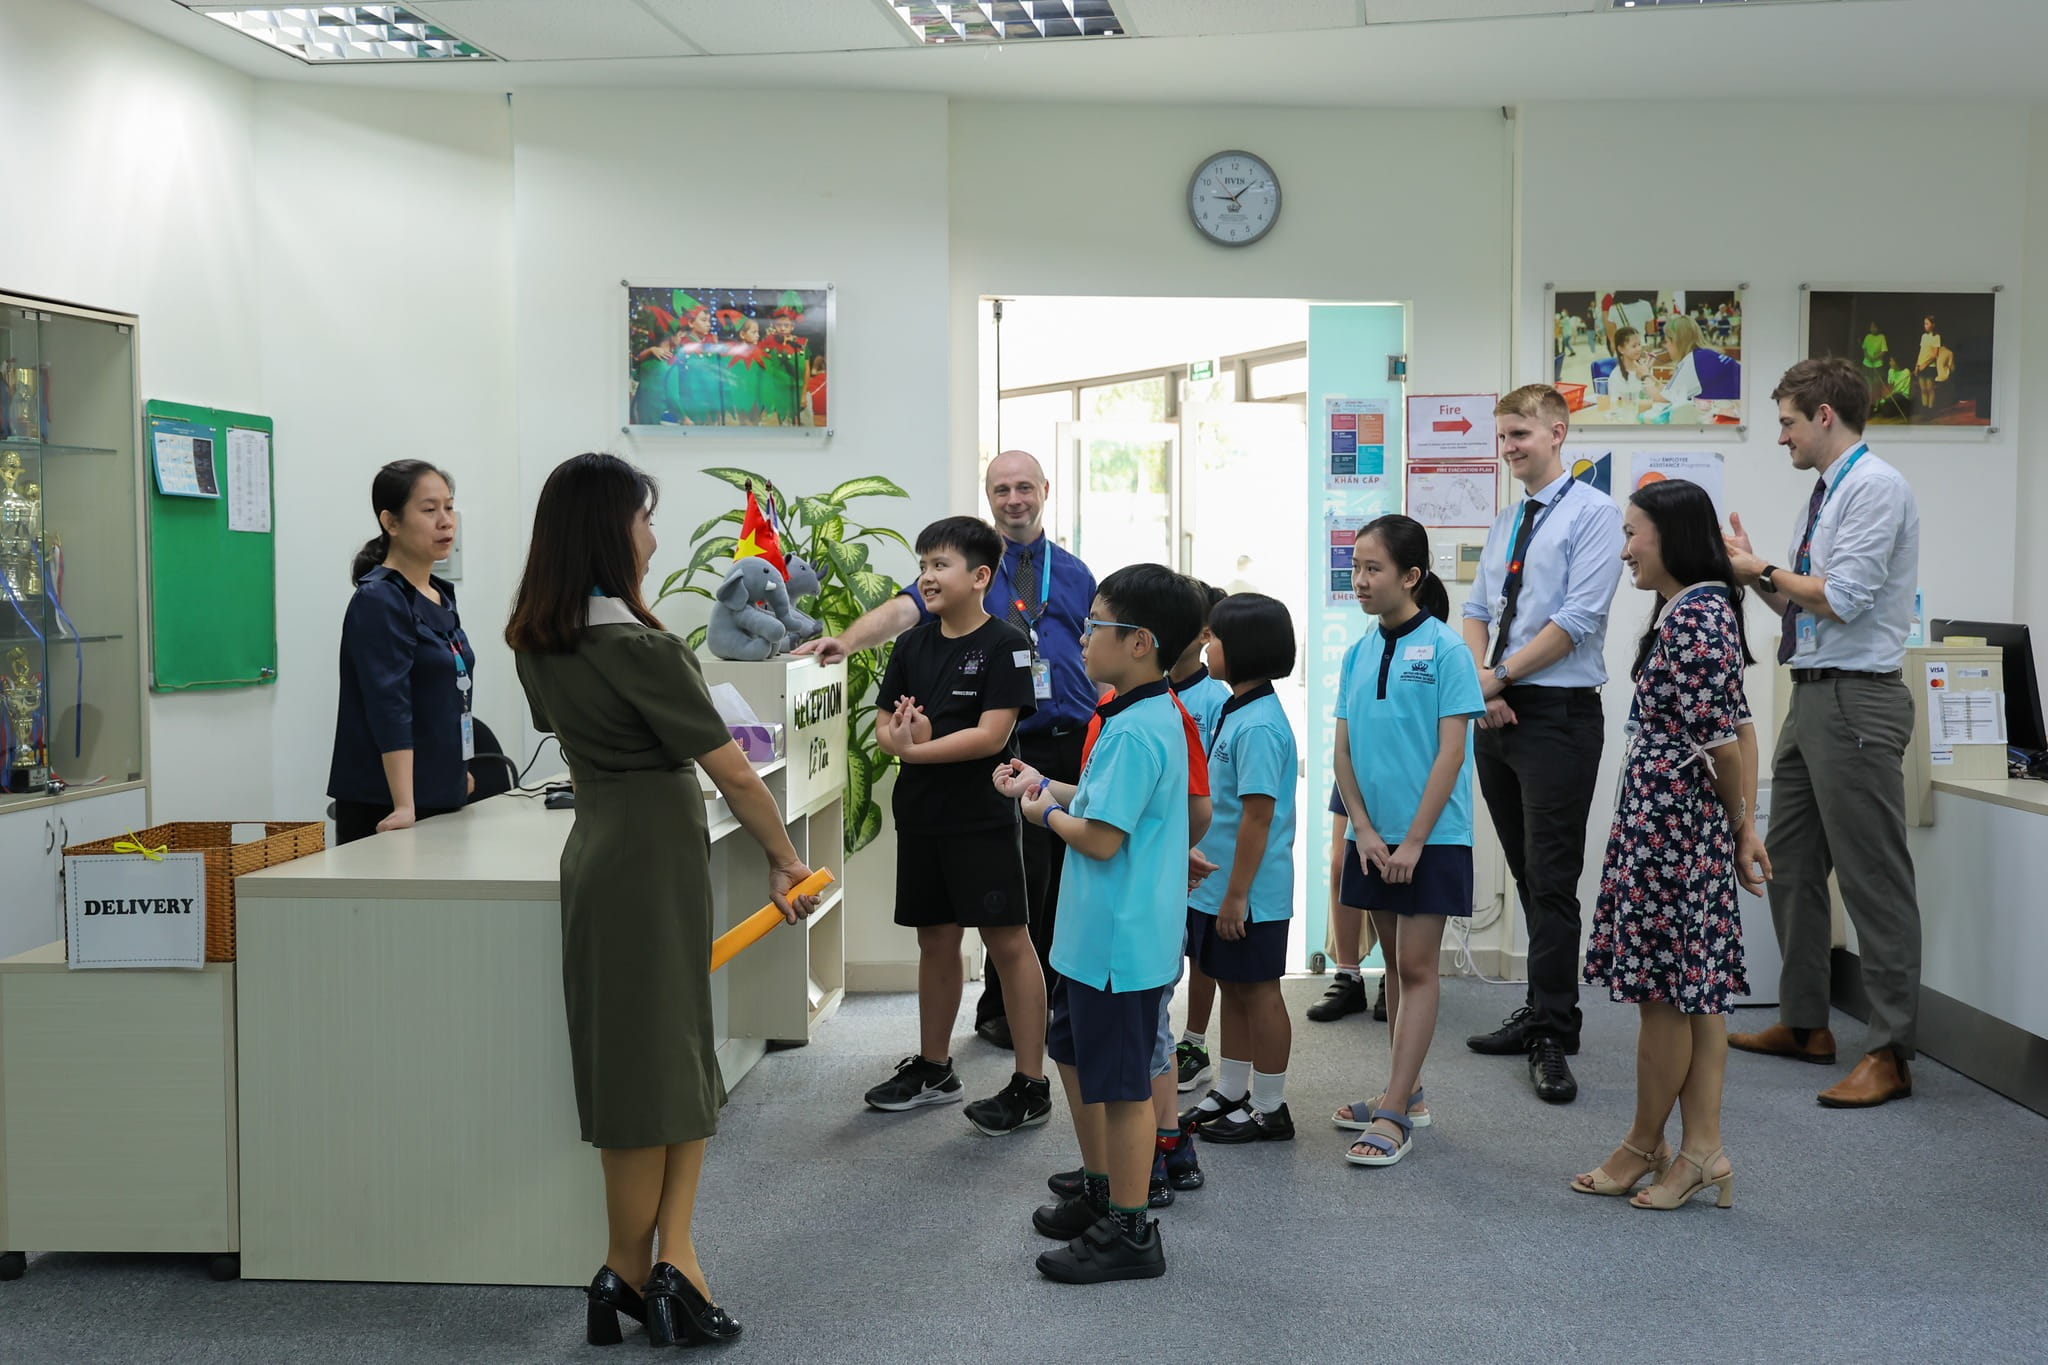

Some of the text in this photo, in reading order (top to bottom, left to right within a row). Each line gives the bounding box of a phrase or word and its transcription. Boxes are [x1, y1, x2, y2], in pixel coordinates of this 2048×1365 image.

[1215, 167, 1223, 175] 11
[1224, 176, 1246, 184] BVIS
[1263, 197, 1268, 205] 3
[1439, 404, 1461, 415] Fire
[84, 898, 194, 916] DELIVERY
